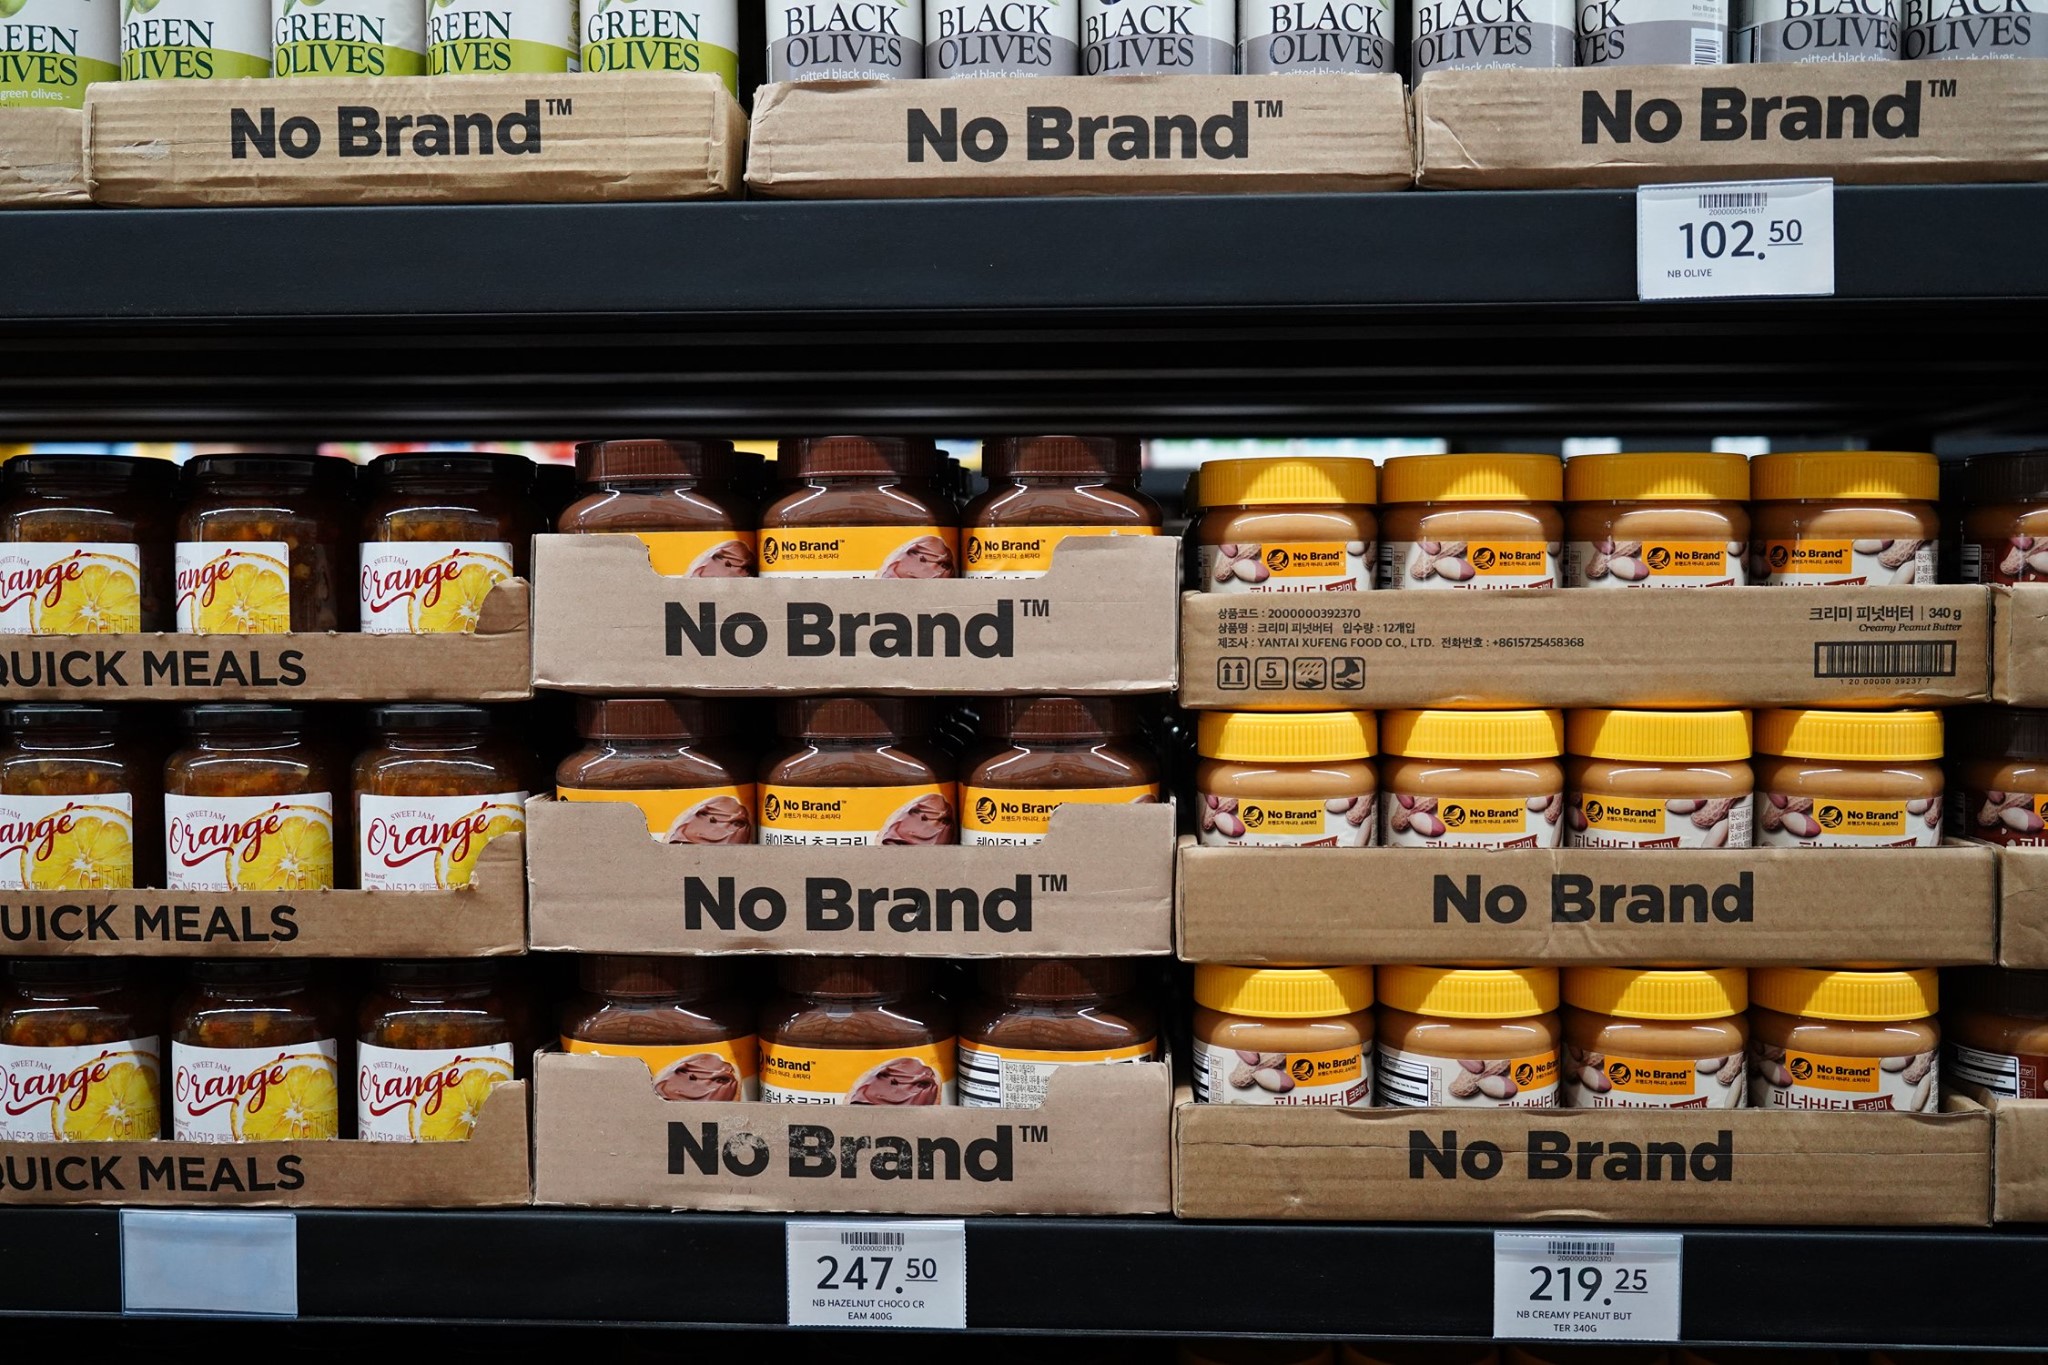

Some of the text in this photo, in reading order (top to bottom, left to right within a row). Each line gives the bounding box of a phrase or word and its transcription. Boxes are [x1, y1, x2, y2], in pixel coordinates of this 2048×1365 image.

[587, 9, 700, 43] GREEN
[785, 2, 901, 36] BLACK
[938, 3, 1053, 39] BLACK
[1086, 5, 1193, 46] BLACK
[1270, 1, 1384, 38] BLACK
[1418, 0, 1532, 38] BLACK
[275, 12, 385, 46] GREEN
[1783, 16, 1898, 50] OLIVES
[0, 24, 78, 57] EEN
[1904, 15, 2032, 59] OLIVES
[786, 34, 901, 67] OLIVES
[938, 35, 1052, 69] OLIVES
[1270, 34, 1384, 69] OLIVES
[1418, 25, 1532, 68] OLIVES
[276, 43, 385, 77] OLIVES
[588, 40, 700, 72] OLIVES
[1086, 37, 1194, 75] OLIVES
[0, 54, 78, 86] IVES
[832, 68, 859, 80] black
[862, 67, 890, 79] olives
[0, 87, 63, 100] green olives
[1580, 88, 1683, 144] No
[230, 107, 321, 160] No
[907, 108, 1008, 163] No
[1708, 207, 1765, 217] 2000000541617
[1667, 269, 1713, 278] NB OLIVE
[781, 540, 797, 552] No
[984, 540, 1000, 551] No
[1293, 551, 1308, 561] No
[1500, 551, 1514, 560] No
[1675, 551, 1690, 560] No
[1792, 549, 1806, 558] No
[1218, 608, 1361, 619] 상품코드 2000000392370
[1809, 605, 1962, 622] 크리미 피넛버터 340 g
[665, 600, 769, 659] No
[1218, 622, 1415, 634] 상품명 크리미 피넛버터 입수량 12개입
[1858, 623, 1962, 633] Creamy Peanut Butter
[1218, 637, 1585, 649] 제조사 YANTAI XUFENG FOOD CO., LTD. 전화번호 +8615725458368
[143, 650, 307, 687] MEALS
[783, 799, 799, 811] No
[1001, 802, 1062, 814] No Bran
[1607, 806, 1621, 816] No
[390, 810, 436, 822] SWEET JAM
[1268, 810, 1283, 819] No
[1470, 808, 1485, 818] No
[1847, 810, 1864, 820] No
[684, 875, 787, 932] No
[1433, 871, 1754, 924] No Brand
[134, 904, 299, 942] MEALS
[10, 1059, 52, 1072] SWEET JAM
[765, 1054, 776, 1067] No
[1318, 1061, 1331, 1070] No
[1635, 1068, 1651, 1078] No
[1817, 1064, 1832, 1074] No
[667, 1121, 770, 1178] No
[1409, 1130, 1733, 1182] No Brand
[0, 1155, 305, 1193] UICK MEALS
[812, 1298, 925, 1309] NB HAZELNUT CHOCO CR
[847, 1311, 893, 1321] EAM 400G
[1516, 1310, 1632, 1321] NB CREAMY PEANUT BUT
[1553, 1323, 1598, 1333] TER 340G
